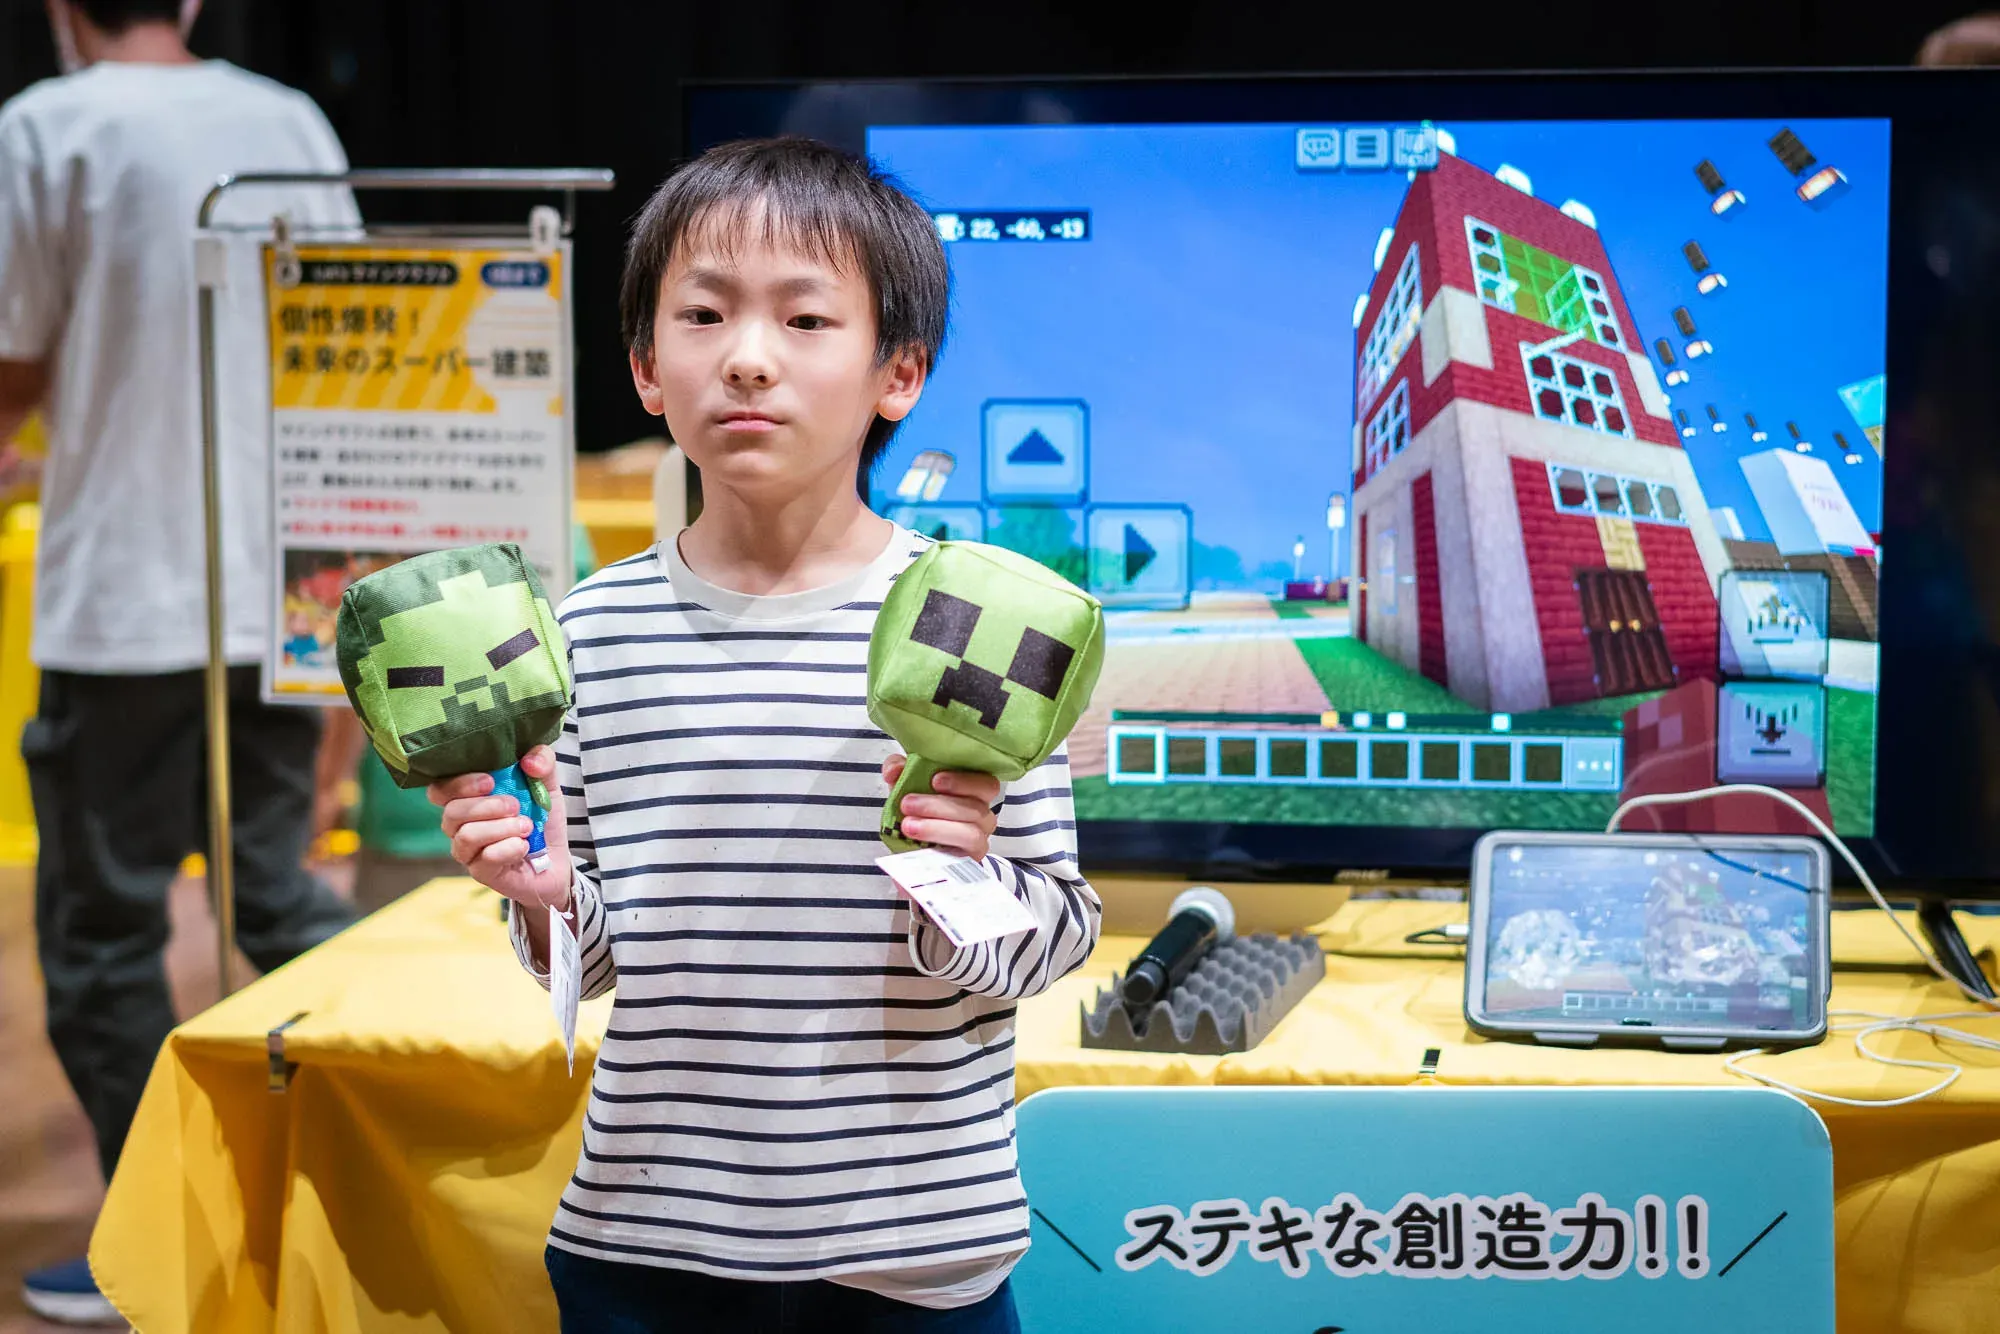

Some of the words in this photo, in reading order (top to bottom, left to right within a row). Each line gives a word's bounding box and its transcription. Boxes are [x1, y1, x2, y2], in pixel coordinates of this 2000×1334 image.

[1124, 1200, 1702, 1271] ステキな創造力!!
